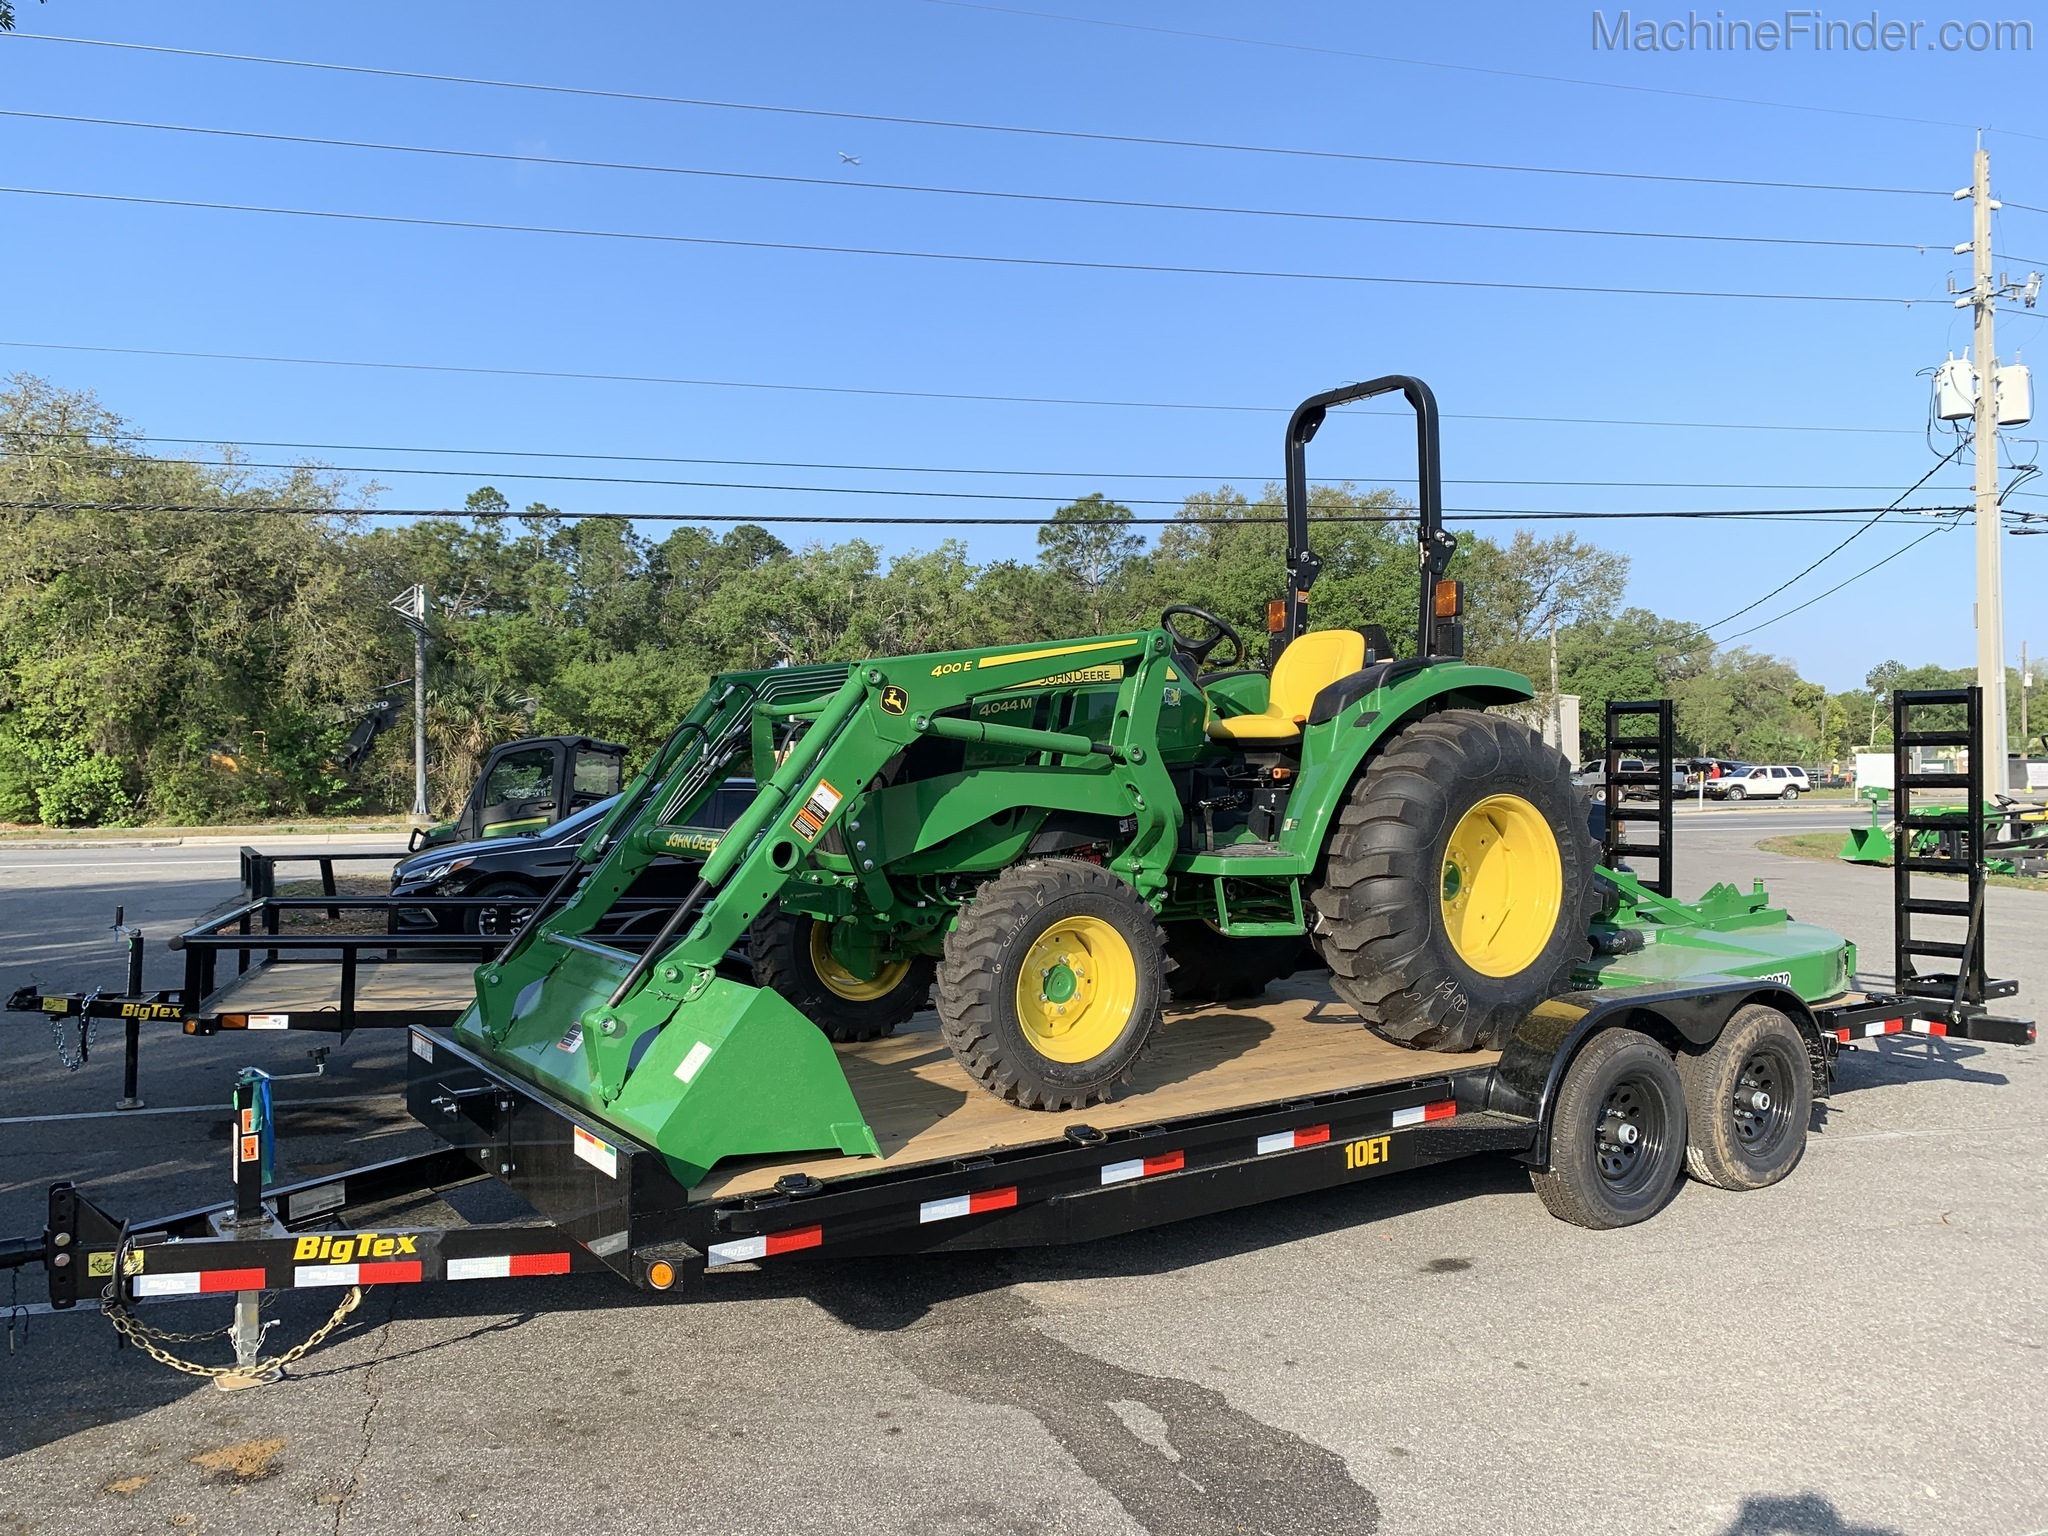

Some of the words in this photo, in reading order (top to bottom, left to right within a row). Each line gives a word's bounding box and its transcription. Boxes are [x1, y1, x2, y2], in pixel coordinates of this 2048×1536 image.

[931, 662, 962, 677] 400
[963, 660, 973, 671] E
[1074, 669, 1110, 682] DEERE
[979, 701, 1018, 716] 4044
[1019, 697, 1032, 709] M
[666, 832, 691, 849] JOHN
[121, 1004, 182, 1020] BigTex
[1345, 1135, 1391, 1170] 10ET
[293, 1233, 419, 1265] BigTex
